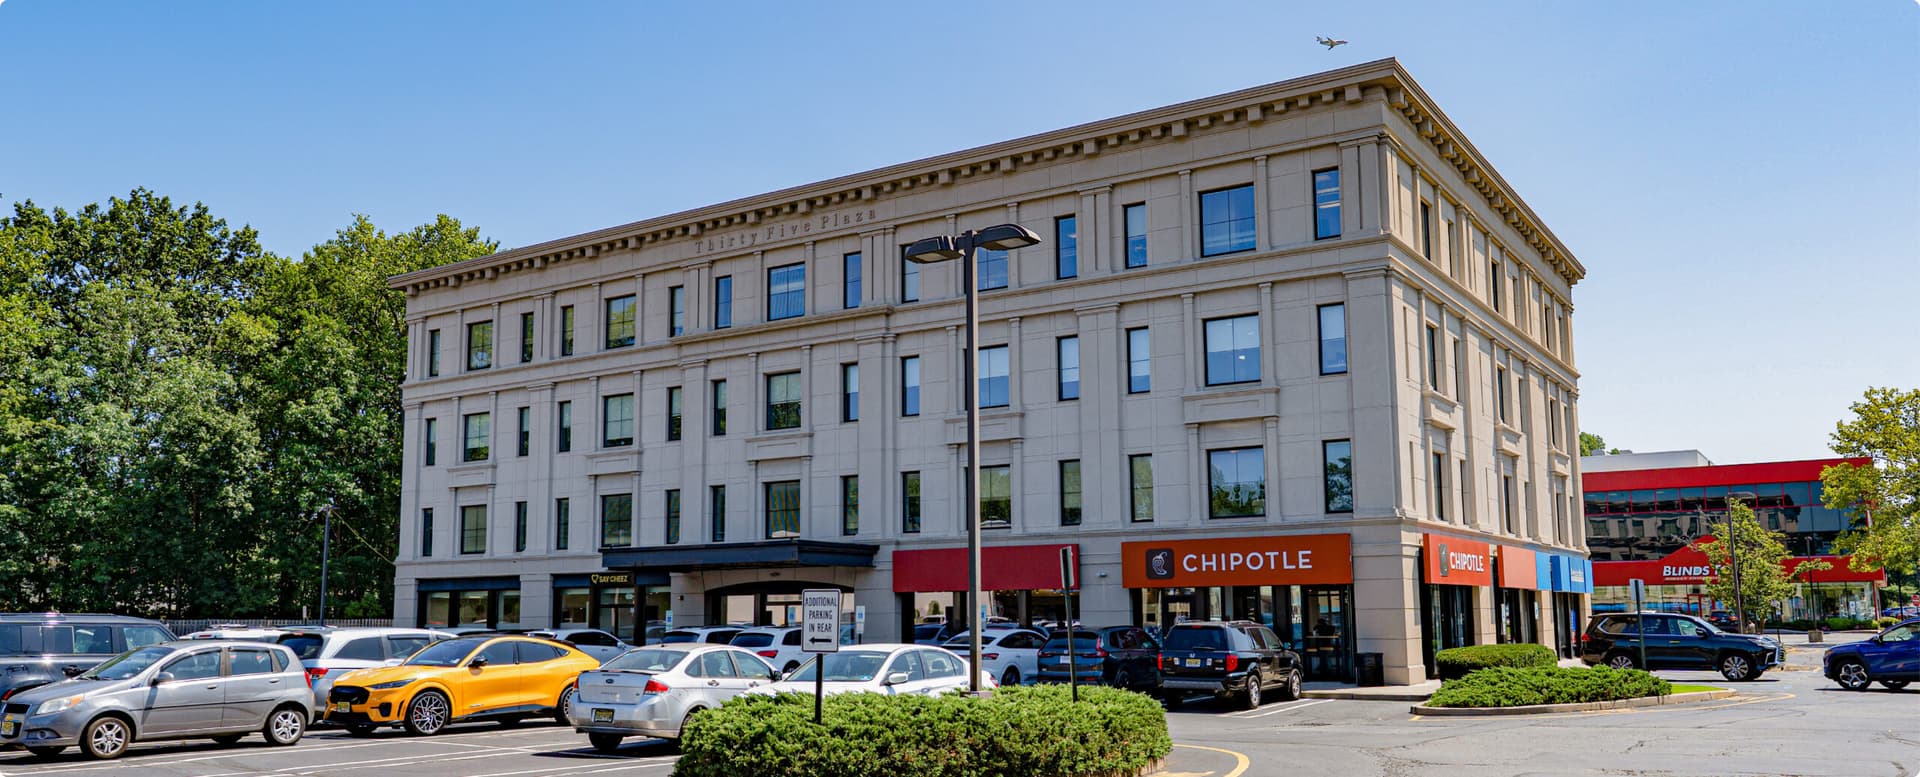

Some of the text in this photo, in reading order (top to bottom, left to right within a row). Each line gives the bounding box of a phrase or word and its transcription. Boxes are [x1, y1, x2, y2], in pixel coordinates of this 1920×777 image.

[695, 210, 876, 253] Thirty Five Plaza
[1182, 550, 1313, 572] CHIPOTLE
[1449, 551, 1485, 572] CHIPOTLE
[1663, 565, 1710, 576] BLINDS
[805, 596, 837, 607] ADDITIONAL
[808, 610, 833, 620] PARKING
[808, 623, 833, 633] IN REAR
